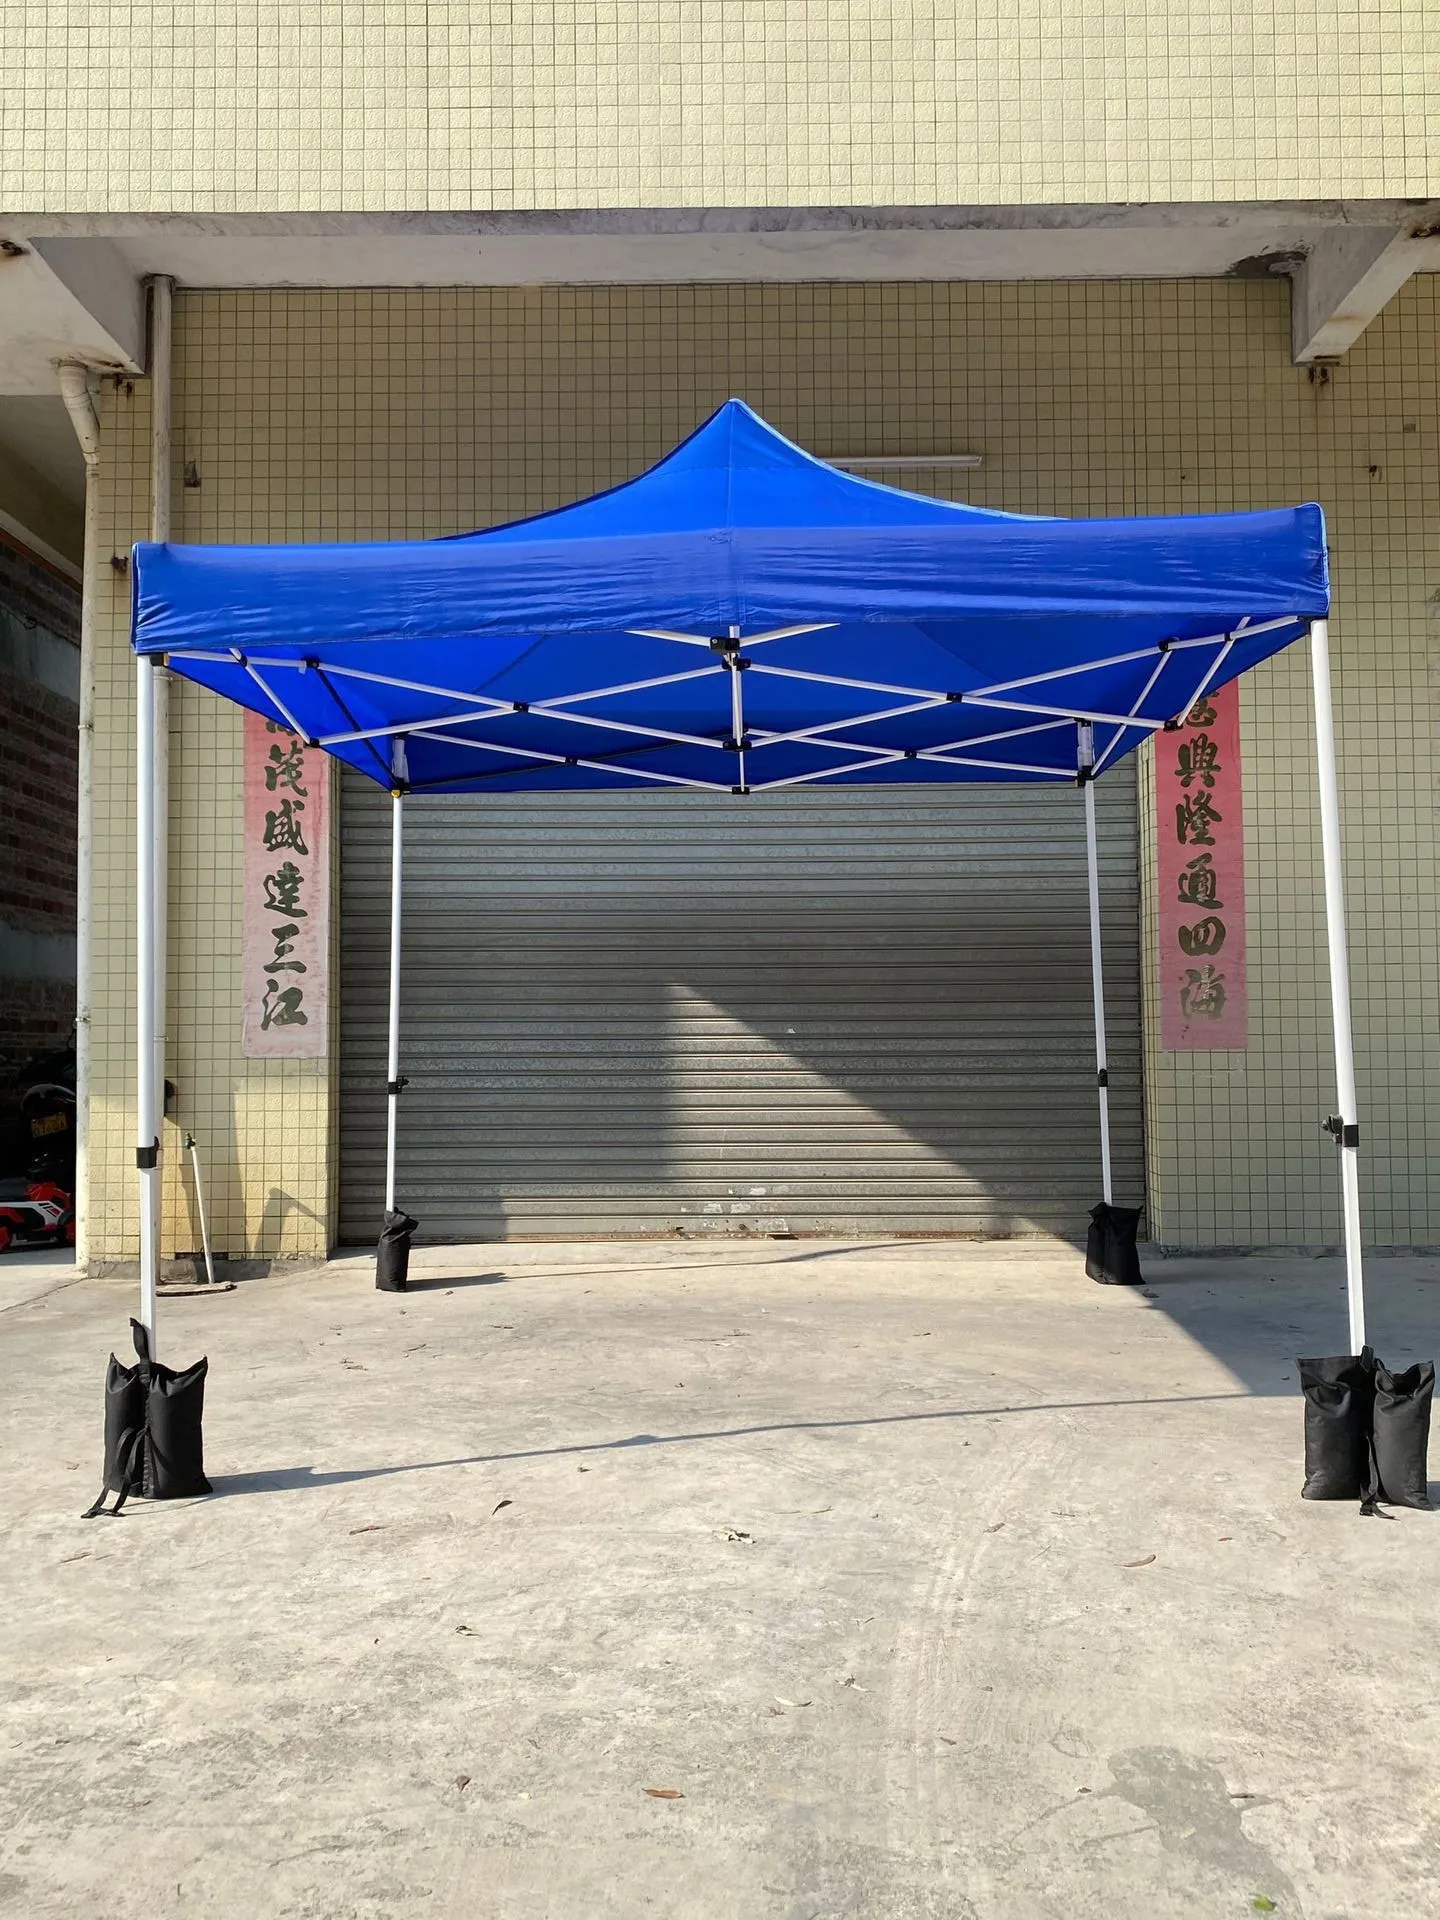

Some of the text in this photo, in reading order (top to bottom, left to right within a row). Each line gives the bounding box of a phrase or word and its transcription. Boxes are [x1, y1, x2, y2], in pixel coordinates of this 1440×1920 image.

[262, 719, 309, 1030] 茂盛達三江
